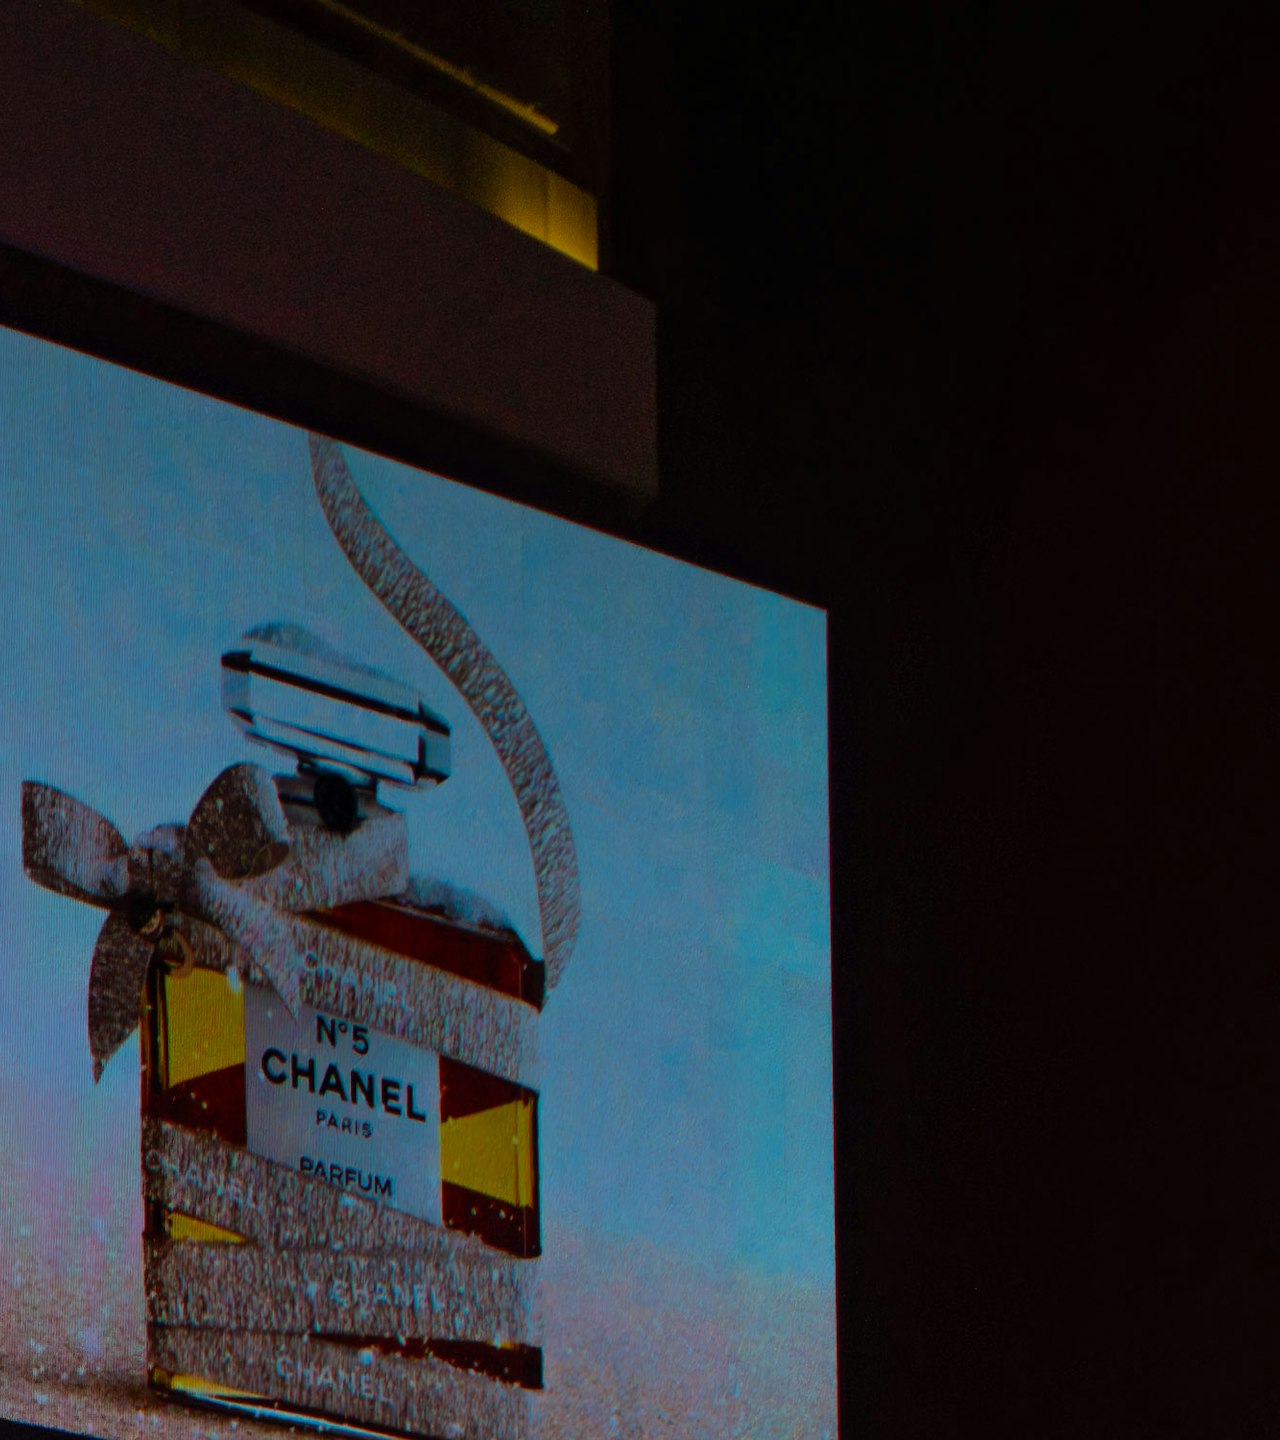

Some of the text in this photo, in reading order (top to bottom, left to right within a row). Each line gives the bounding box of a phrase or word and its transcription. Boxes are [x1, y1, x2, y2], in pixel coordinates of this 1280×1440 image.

[261, 1048, 427, 1123] CHANEL
[316, 1110, 374, 1139] PARIS
[300, 1156, 393, 1197] PARFUM
